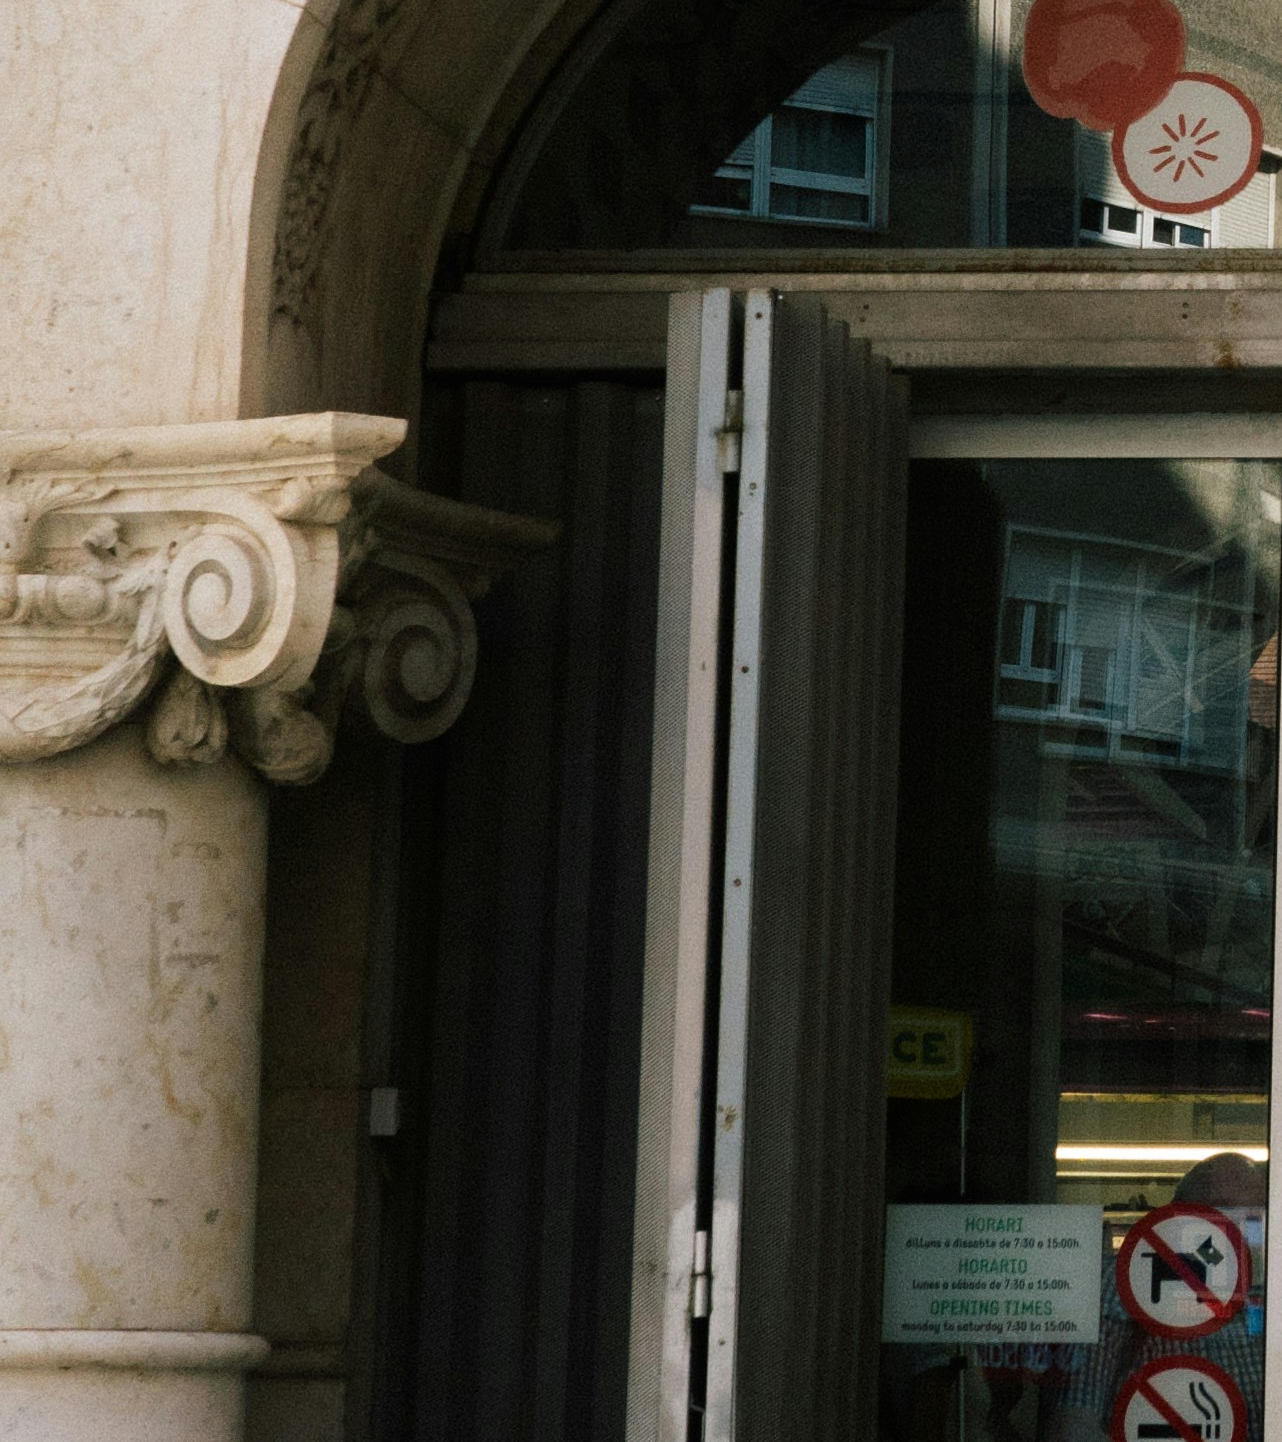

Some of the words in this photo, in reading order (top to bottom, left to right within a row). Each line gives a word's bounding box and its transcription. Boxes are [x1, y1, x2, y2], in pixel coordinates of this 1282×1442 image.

[965, 1217, 1023, 1233] HORARI
[999, 1238, 1011, 1248] de
[1014, 1238, 1035, 1248] 7:30
[959, 1259, 1027, 1274] HORARIO
[989, 1279, 1001, 1290] de
[1004, 1279, 1025, 1290] 7:30
[931, 1301, 999, 1315] OPENING
[1005, 1300, 1053, 1316] TIMES
[1006, 1321, 1027, 1331] 7:30
